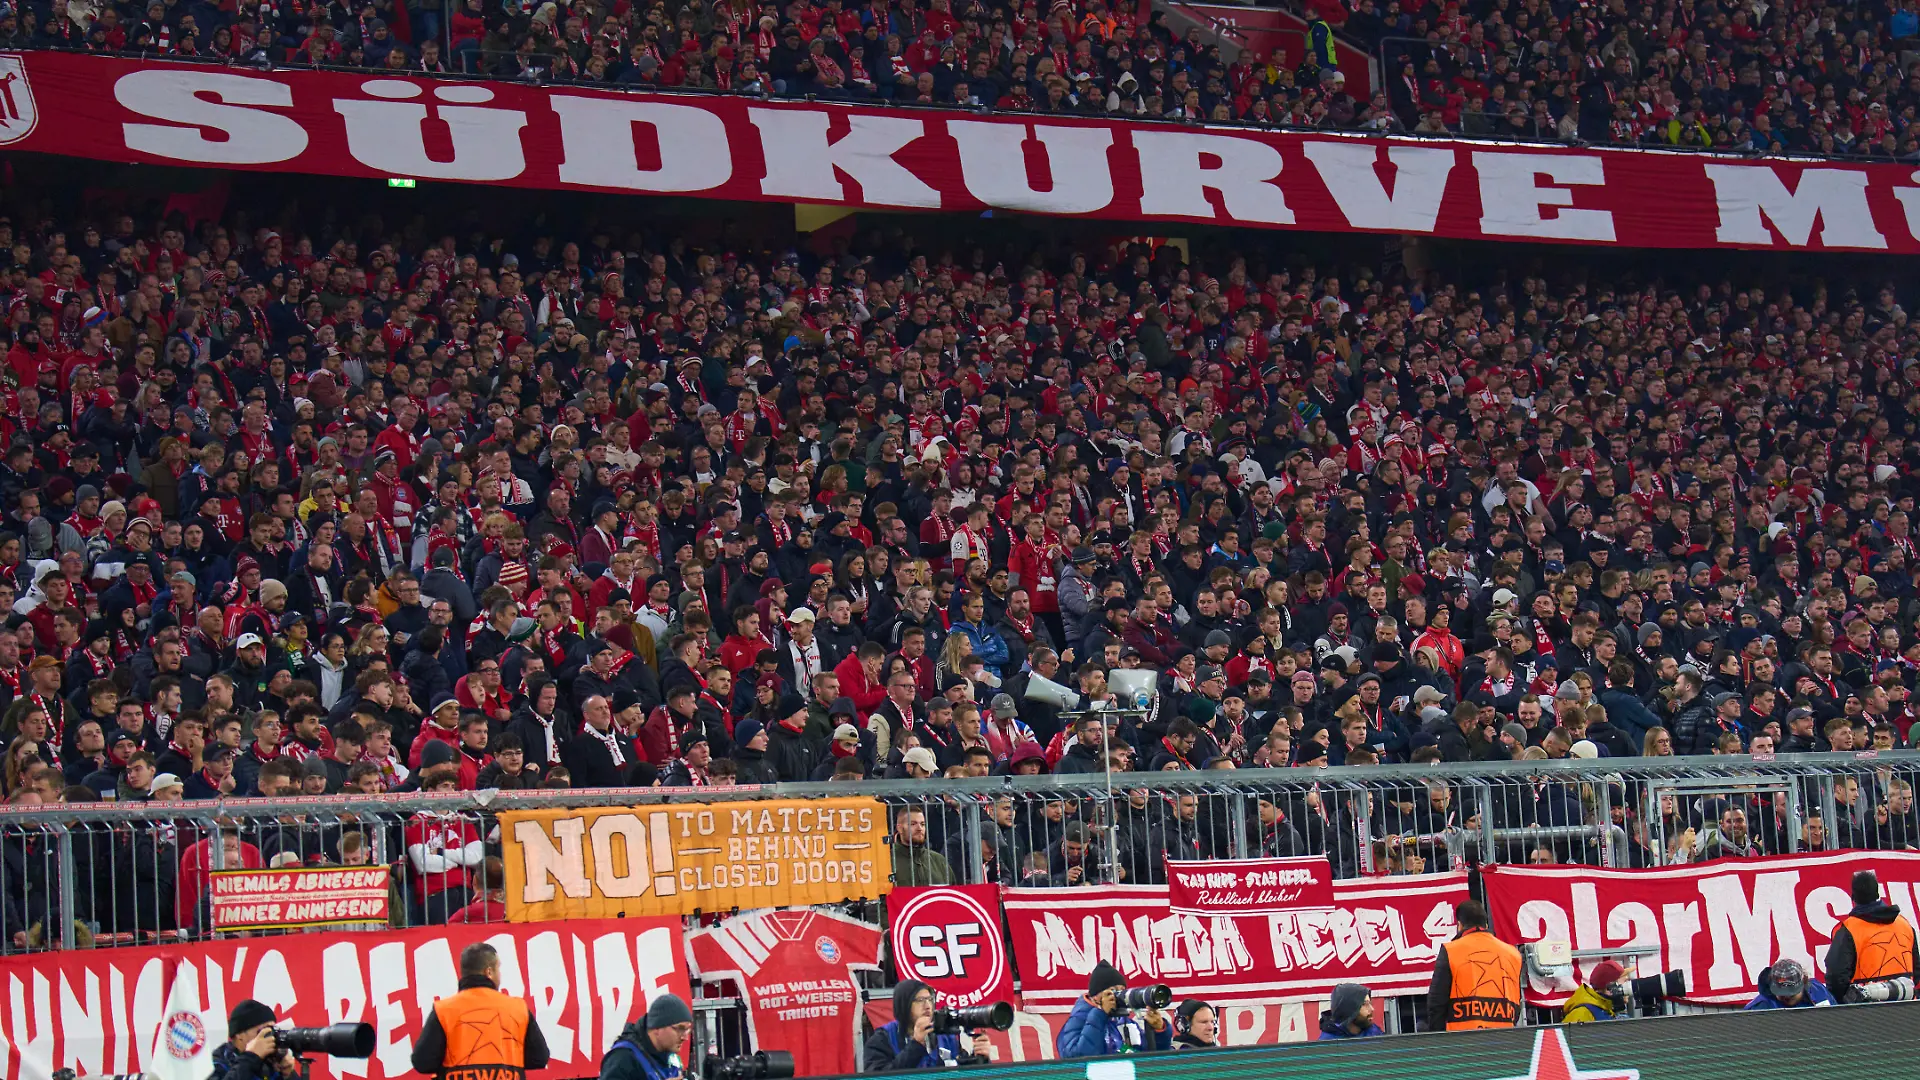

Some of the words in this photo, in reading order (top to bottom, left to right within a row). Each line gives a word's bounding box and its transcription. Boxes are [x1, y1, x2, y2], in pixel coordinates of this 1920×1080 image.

[114, 69, 1617, 242] SÜDKURVE
[676, 810, 715, 837] TO
[731, 808, 872, 835] MATCHES
[513, 812, 676, 903] NO!
[727, 835, 827, 862] BEHIND
[216, 874, 291, 893] NIEMALS
[294, 870, 387, 891] ABWESEND
[679, 861, 779, 892] CLOSED
[793, 859, 872, 884] DOORS
[1196, 890, 1253, 905] Rebellisch
[1255, 888, 1302, 904] bleiben!
[218, 903, 281, 923] IMMER
[285, 899, 384, 920] ANWESEND
[909, 922, 981, 978] SF
[1031, 911, 1254, 980] MUNICH
[1267, 900, 1458, 973] REBELS
[754, 983, 786, 996] WIR
[788, 979, 852, 992] WOLLEN
[936, 988, 983, 1007] FCBM
[759, 991, 853, 1010] ROT-WEISSE
[777, 1005, 839, 1021] TRIKOTS
